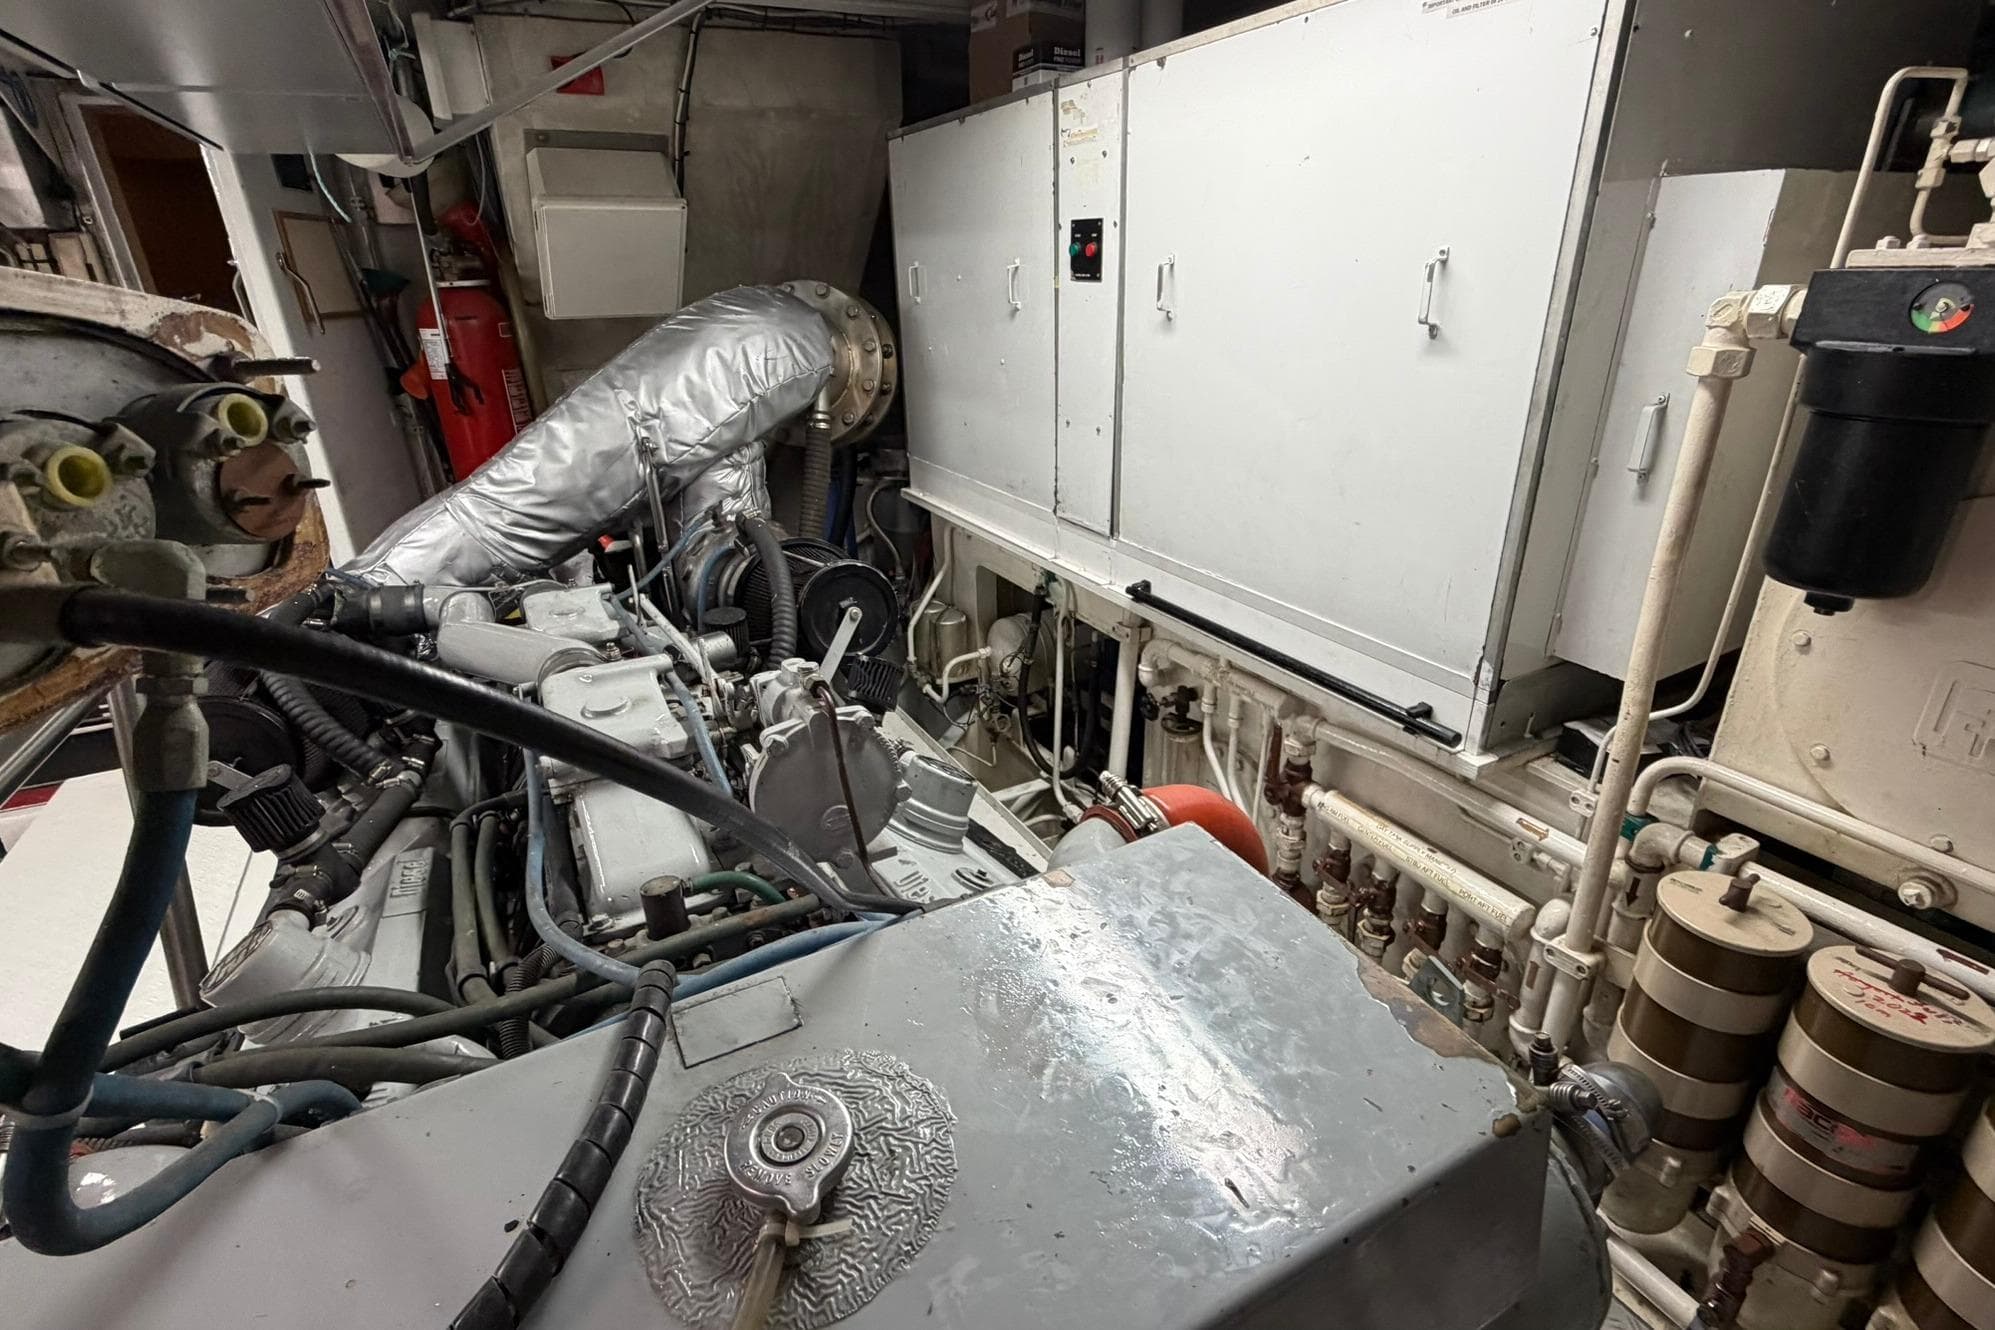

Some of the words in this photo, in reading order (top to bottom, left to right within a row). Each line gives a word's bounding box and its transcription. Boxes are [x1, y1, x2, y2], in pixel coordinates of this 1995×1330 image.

[1422, 866, 1434, 877] AFT
[1433, 872, 1450, 886] FUEL
[1459, 888, 1477, 904] PORT
[1477, 900, 1491, 913] AFT
[1491, 908, 1508, 922] FUEL
[804, 1132, 844, 1178] SLOWLY
